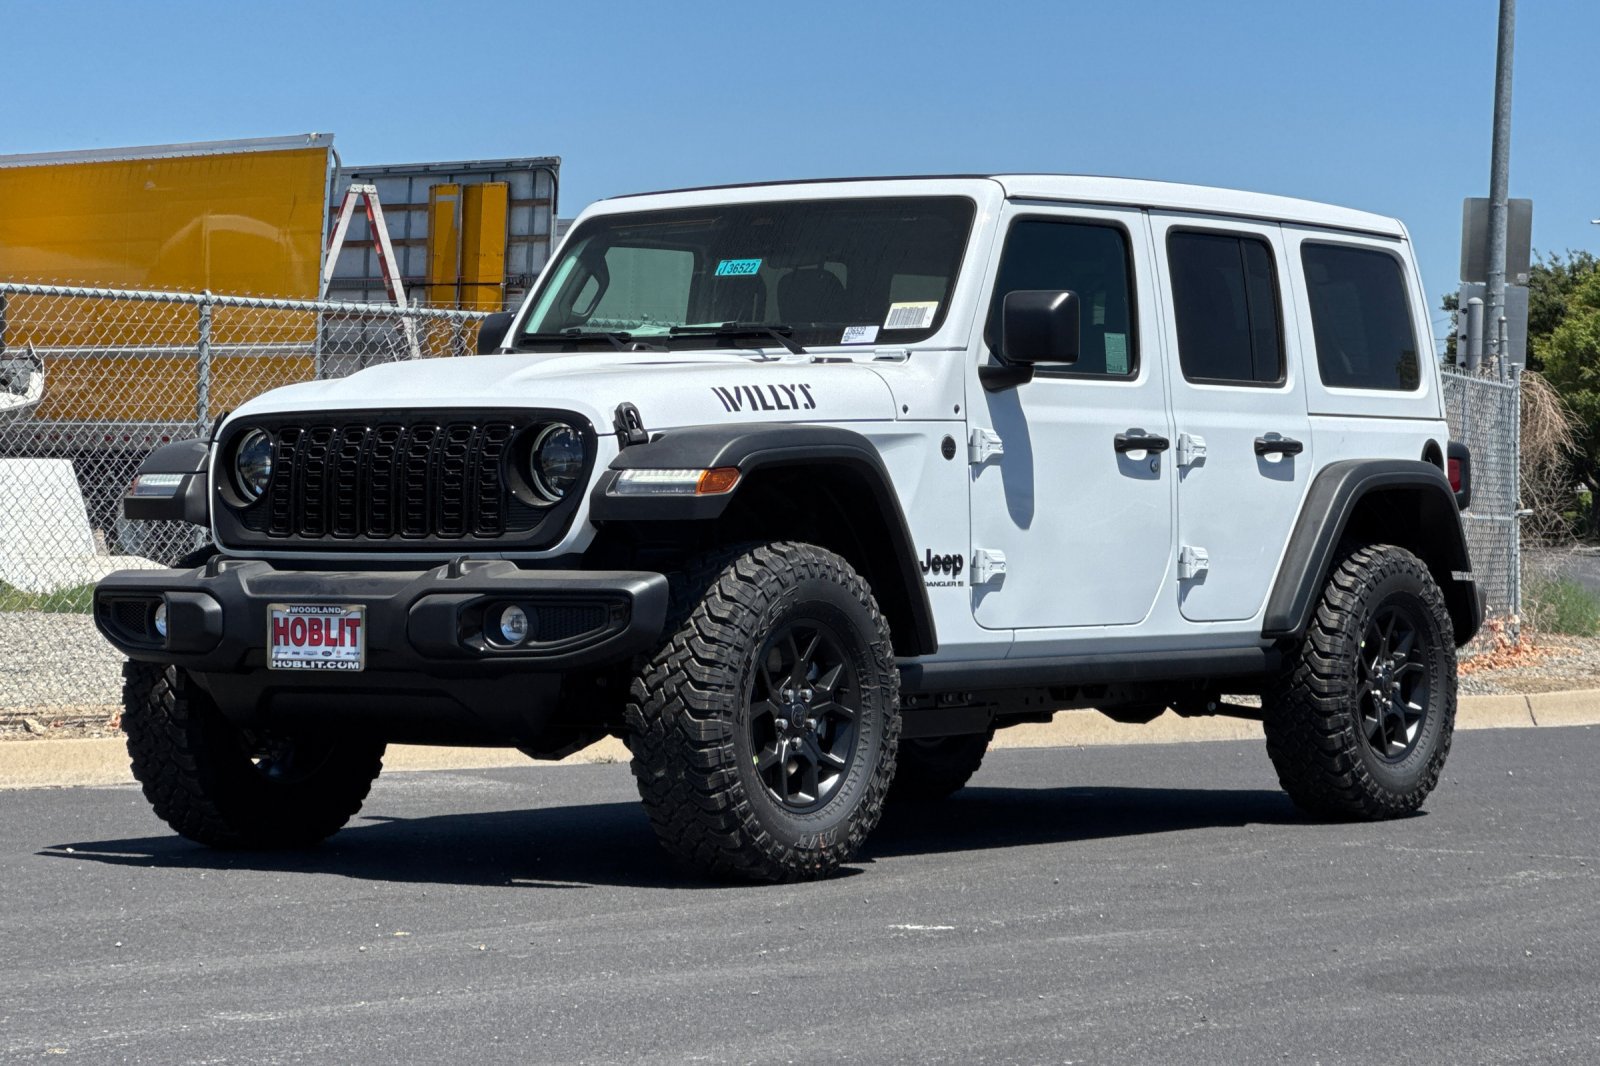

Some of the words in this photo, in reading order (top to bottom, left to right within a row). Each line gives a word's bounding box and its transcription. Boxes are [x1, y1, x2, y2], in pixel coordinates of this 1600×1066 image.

[718, 260, 757, 275] J36522
[711, 384, 816, 412] WILLYS
[920, 548, 964, 580] Jeep
[273, 617, 361, 647] HOBLIT
[273, 661, 359, 669] HOBLIT.COM
